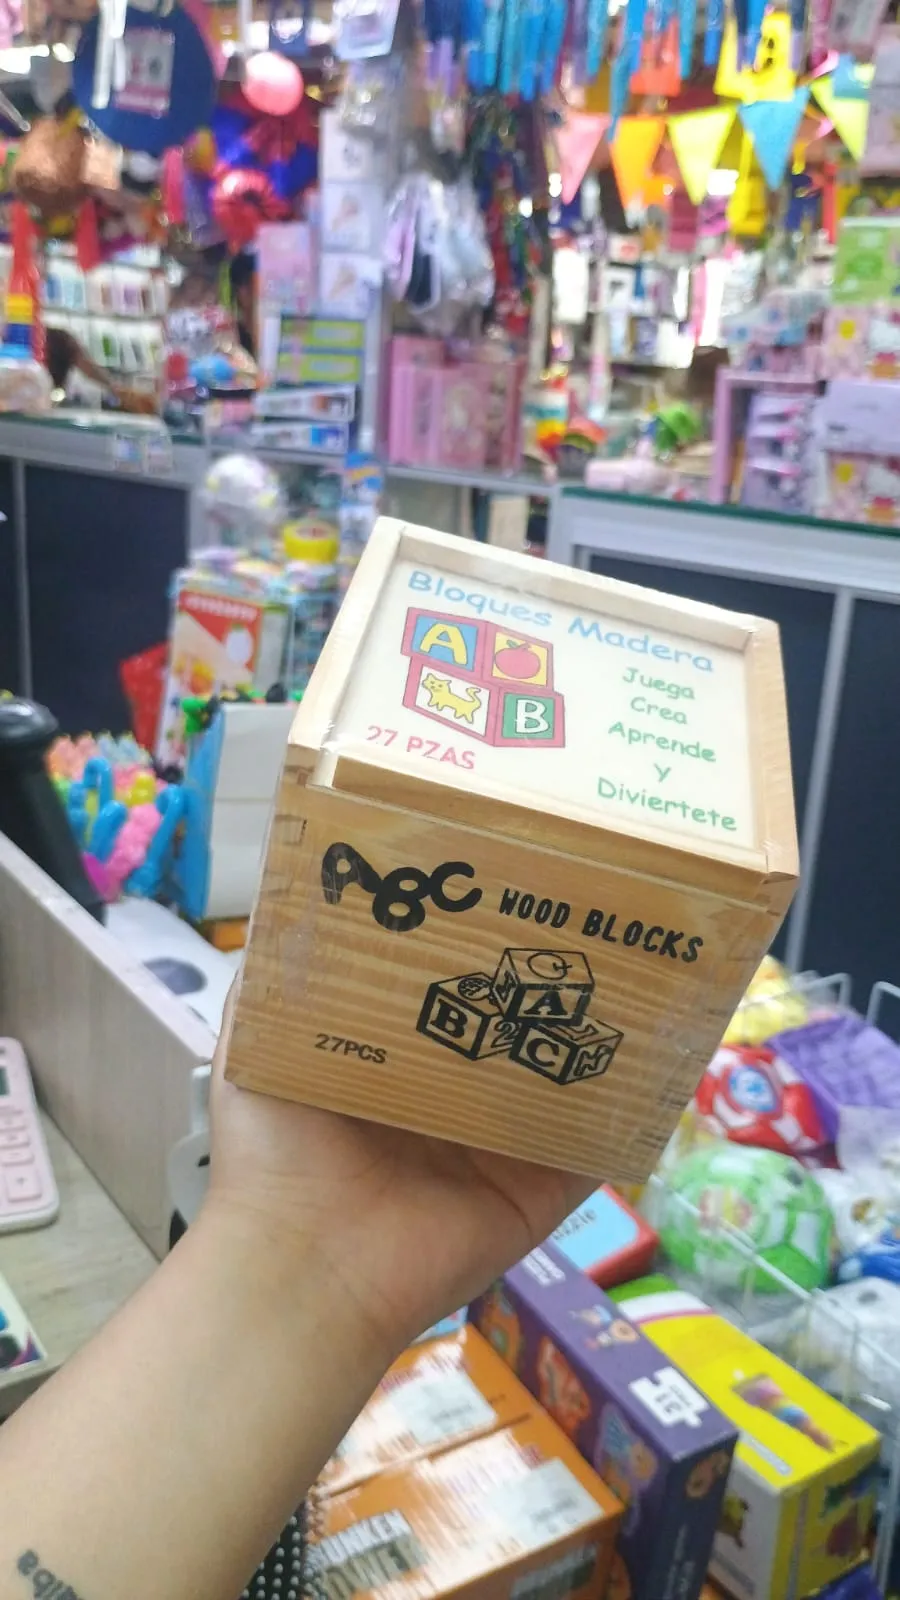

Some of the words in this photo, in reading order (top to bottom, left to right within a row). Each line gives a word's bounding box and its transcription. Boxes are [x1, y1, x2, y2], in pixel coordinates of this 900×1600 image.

[407, 570, 553, 628] Bloques
[567, 616, 715, 674] Madera
[418, 622, 469, 667] A
[622, 666, 696, 701] Juega
[514, 698, 550, 735] B
[629, 696, 688, 726] Crea
[365, 724, 399, 748] 27
[405, 735, 477, 771] PZAS
[607, 721, 717, 763] Aprende
[597, 776, 738, 832] Diviertete
[320, 841, 483, 932] ABC
[498, 887, 571, 930] WOOD
[581, 908, 705, 963] BLOCKS
[314, 1032, 388, 1065] 27PCS
